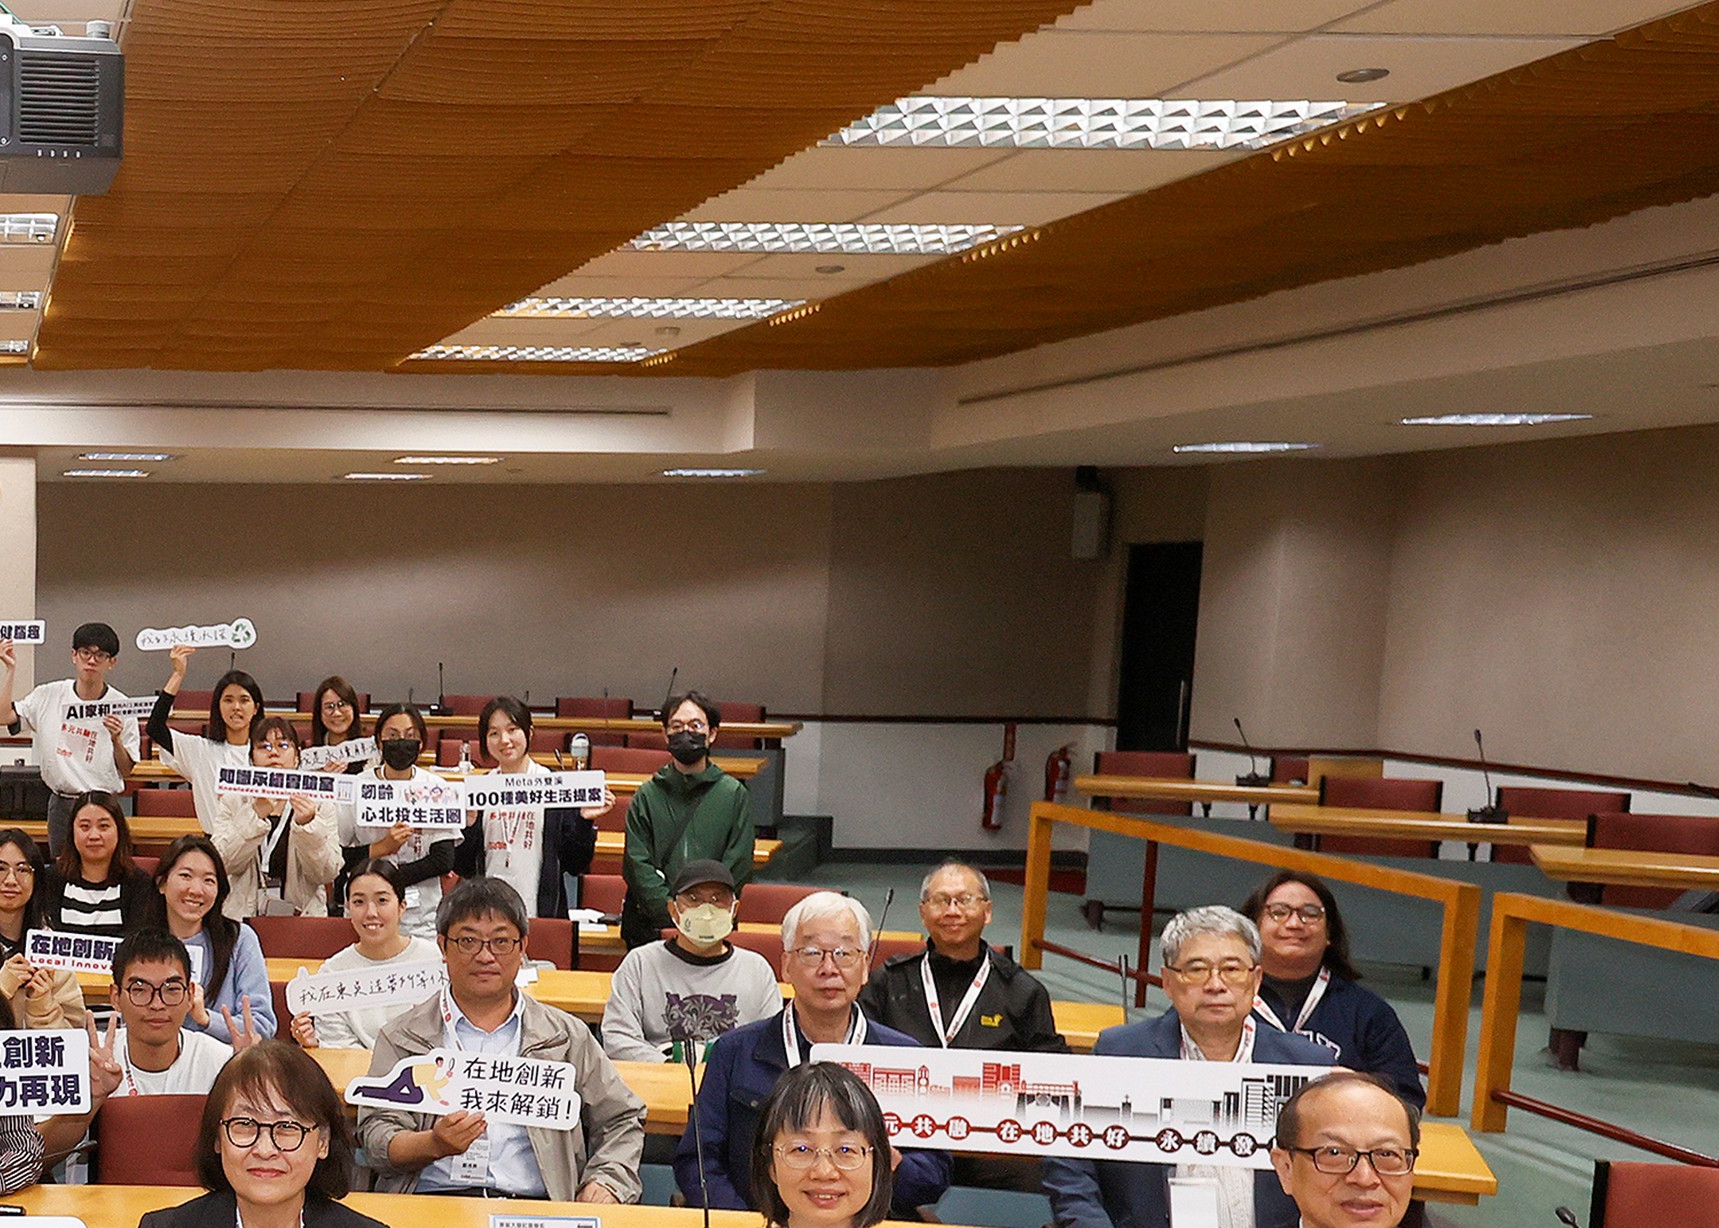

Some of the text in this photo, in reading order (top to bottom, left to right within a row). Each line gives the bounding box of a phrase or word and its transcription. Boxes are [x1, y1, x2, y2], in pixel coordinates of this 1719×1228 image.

[467, 788, 602, 807] 100種美好生活提案
[362, 807, 461, 824] 心北投生活圈
[30, 956, 65, 966] Local
[463, 1057, 566, 1089] 在地創新
[460, 1087, 572, 1120] 我來解鎖!
[1000, 1120, 1128, 1150] 在地共好
